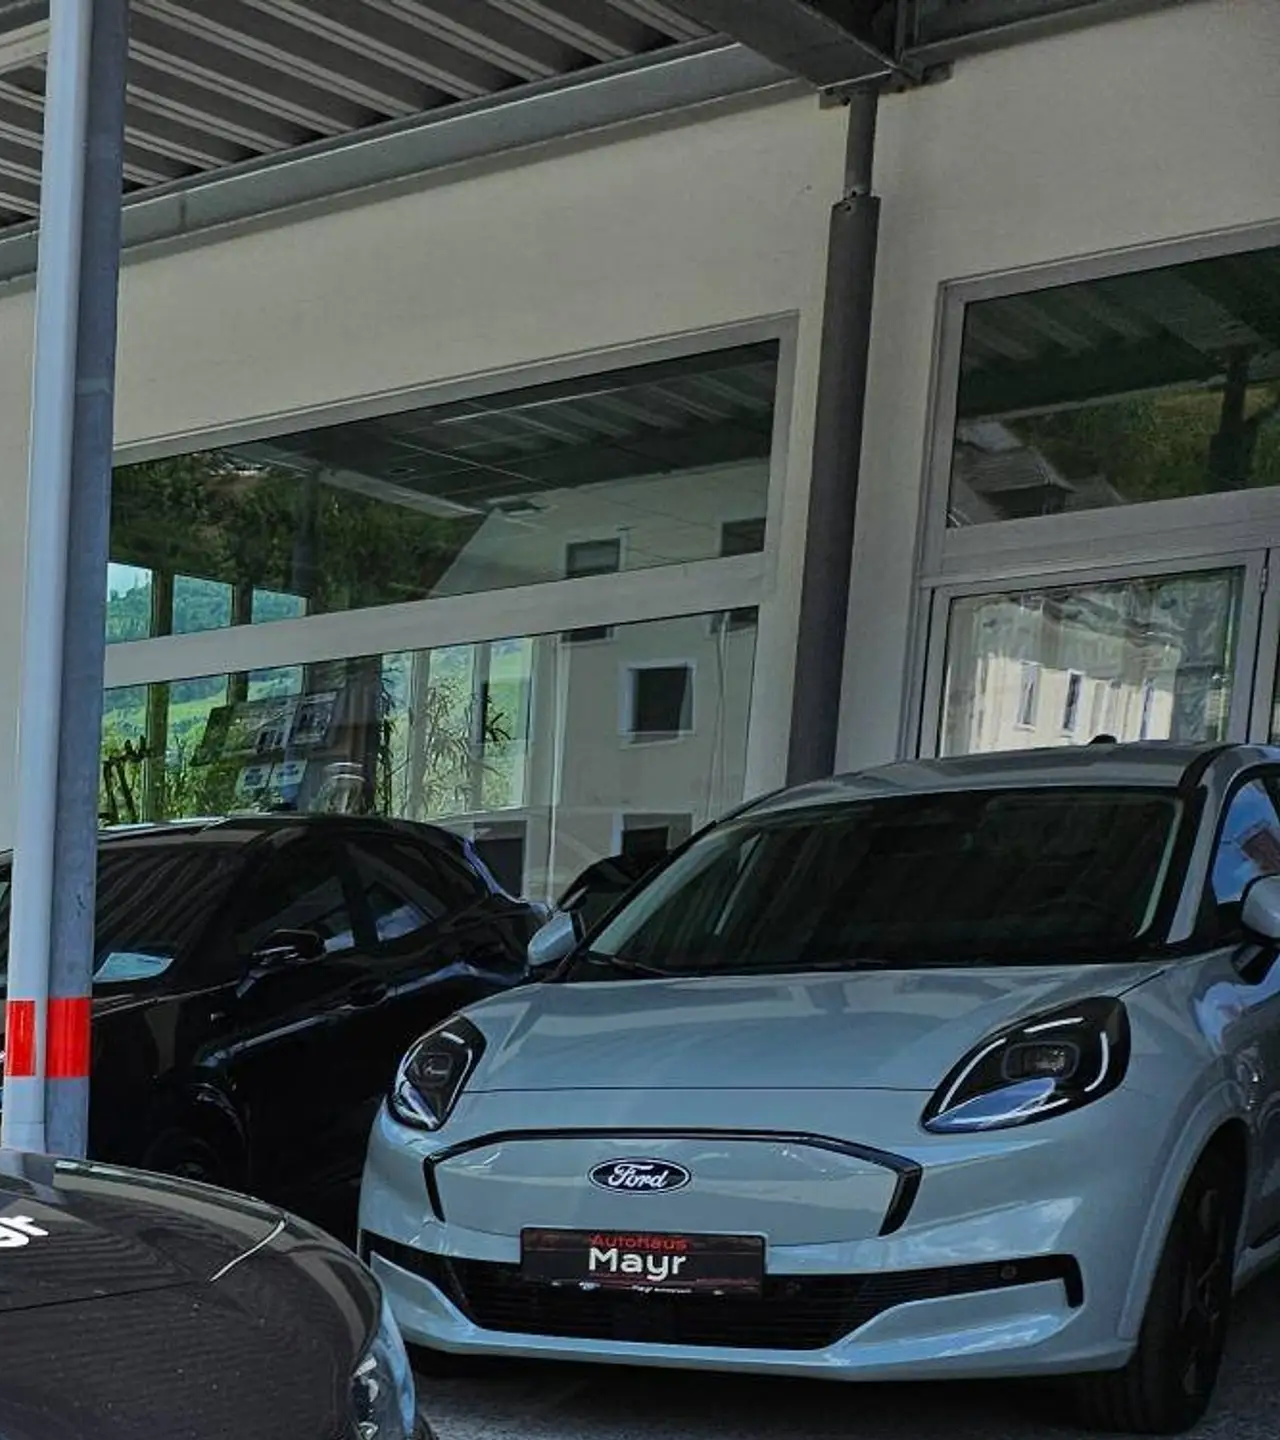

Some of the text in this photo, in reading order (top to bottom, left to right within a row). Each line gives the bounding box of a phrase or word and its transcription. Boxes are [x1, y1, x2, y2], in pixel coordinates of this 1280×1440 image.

[607, 1162, 672, 1190] Ford
[591, 1235, 689, 1251] Autohaus
[589, 1248, 687, 1281] Mayr
